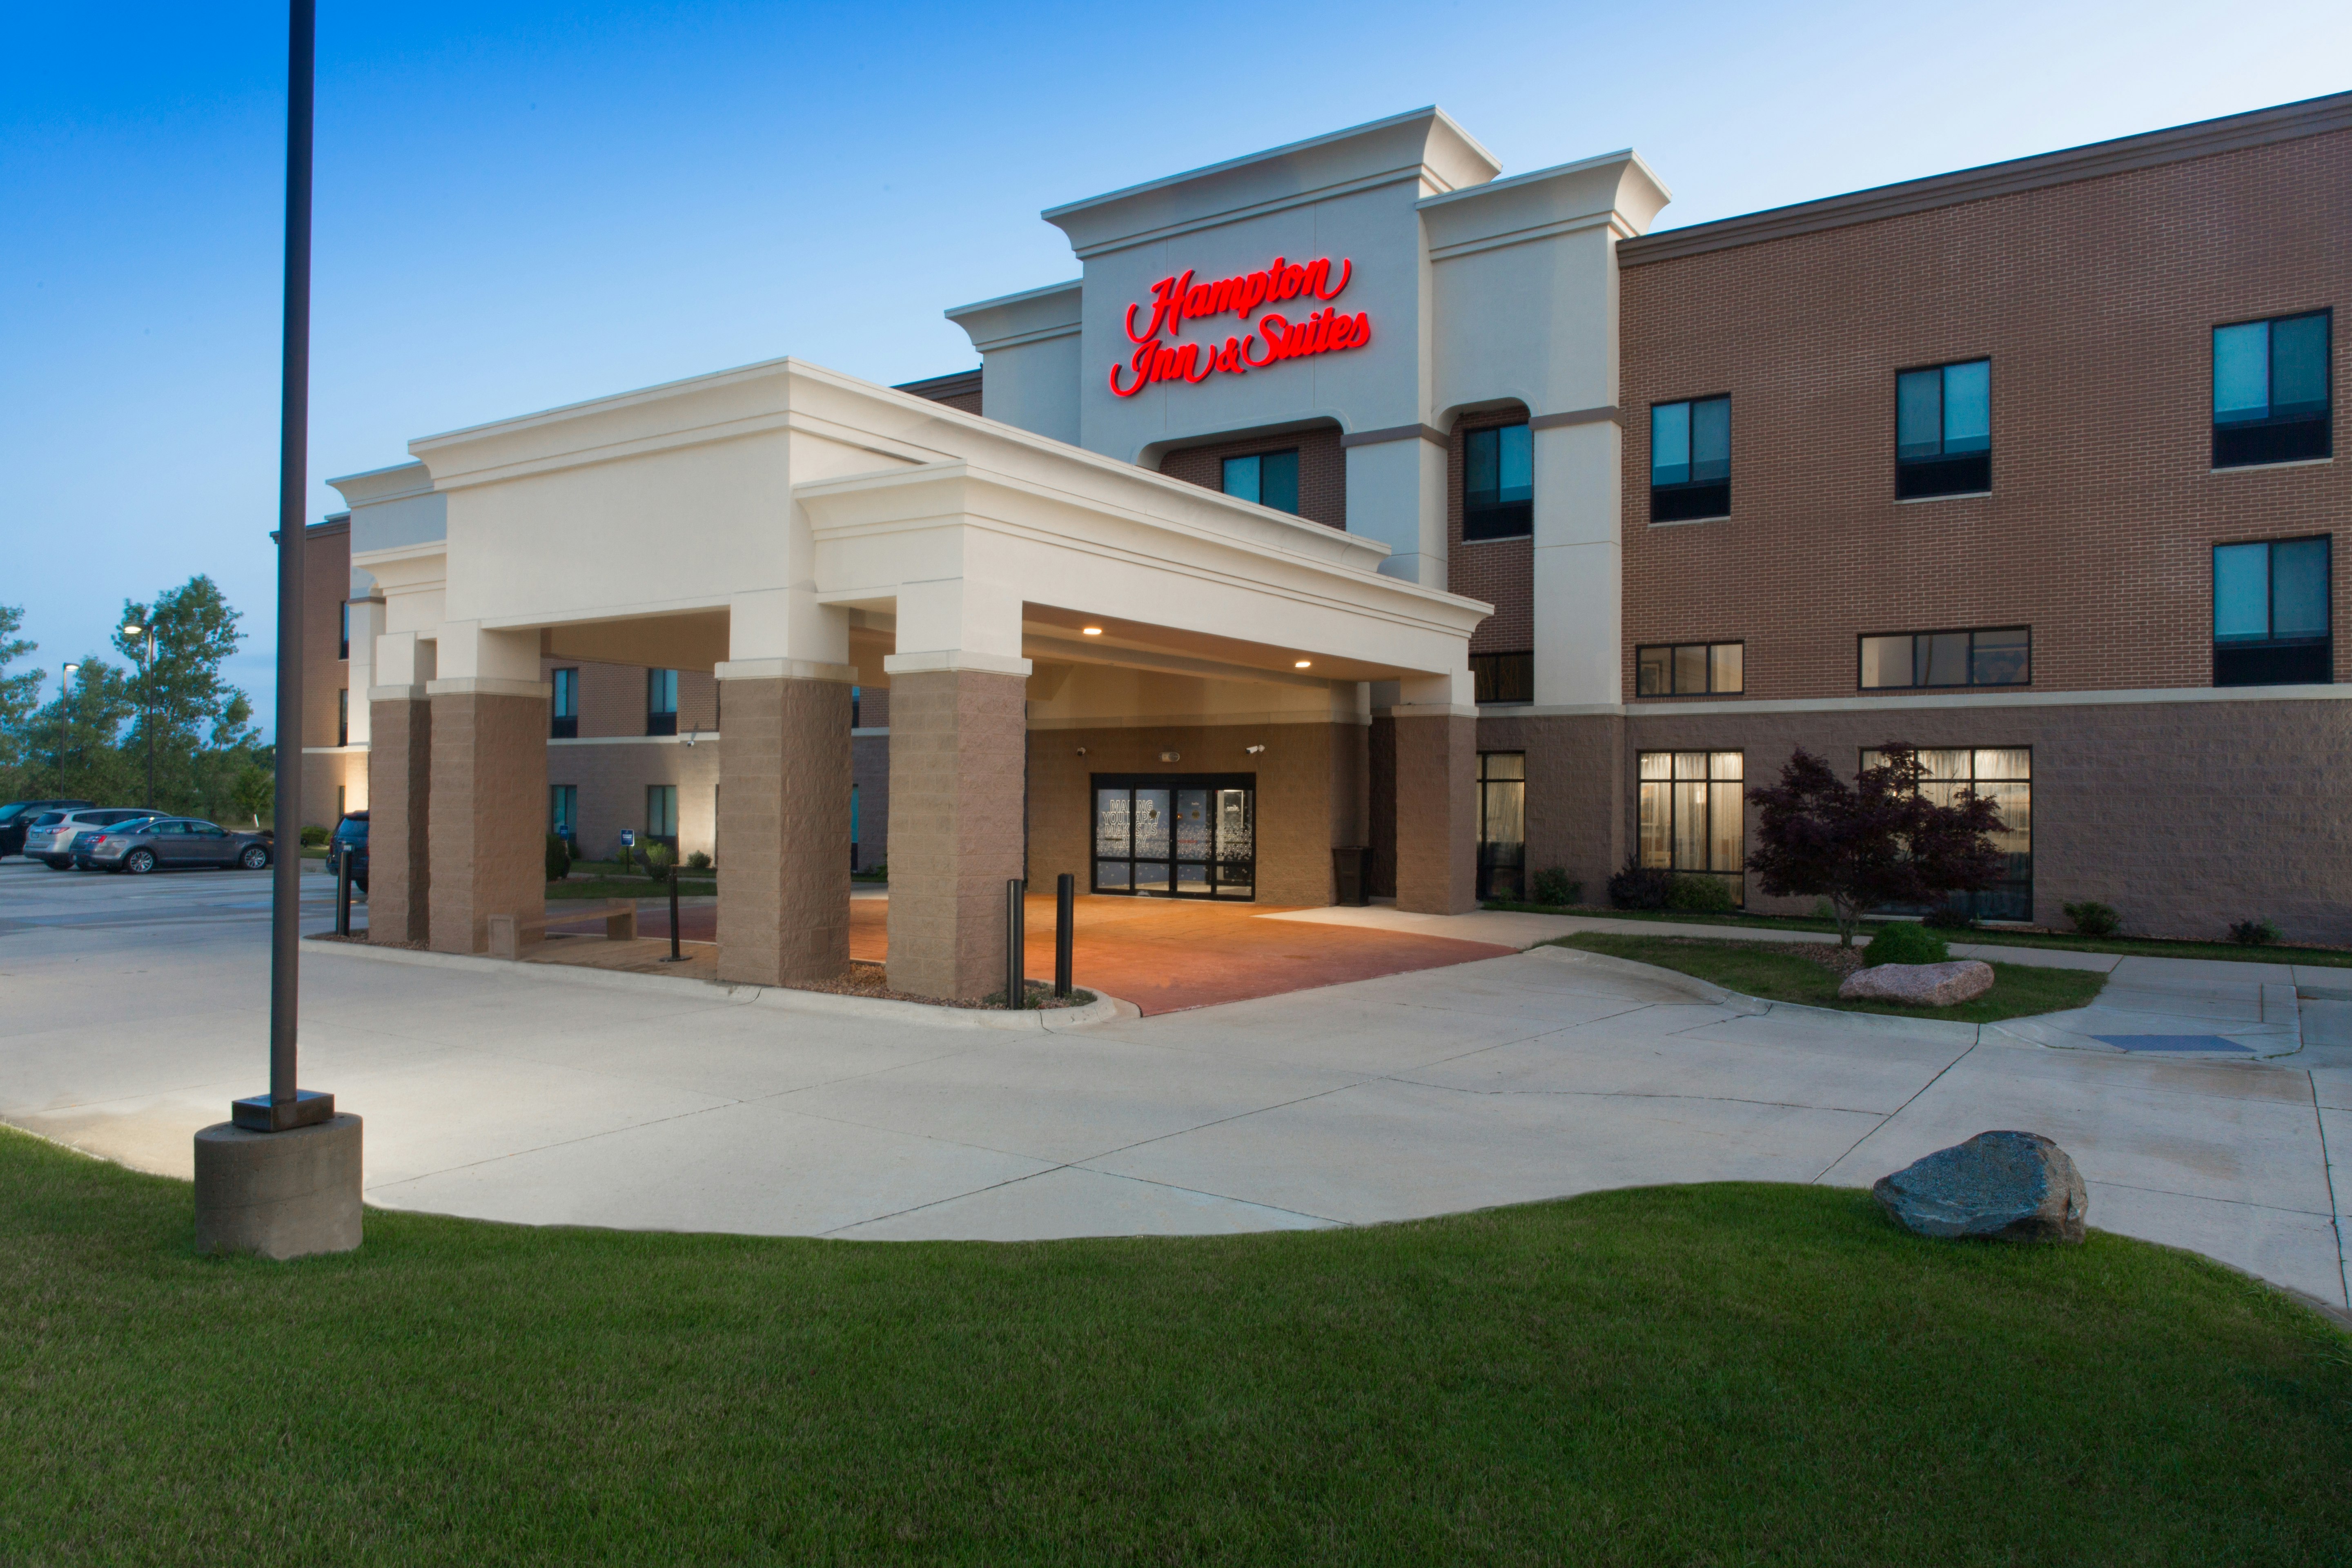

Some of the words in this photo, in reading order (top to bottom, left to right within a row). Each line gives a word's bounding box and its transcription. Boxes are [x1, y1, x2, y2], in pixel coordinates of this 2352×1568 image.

[1126, 257, 1351, 344] Hampton
[1109, 339, 1216, 397] Inn
[1215, 337, 1247, 374] &
[1241, 307, 1371, 367] Suites
[1102, 812, 1125, 825] YOU
[1105, 824, 1142, 836] MAKS
[1145, 823, 1157, 835] US
